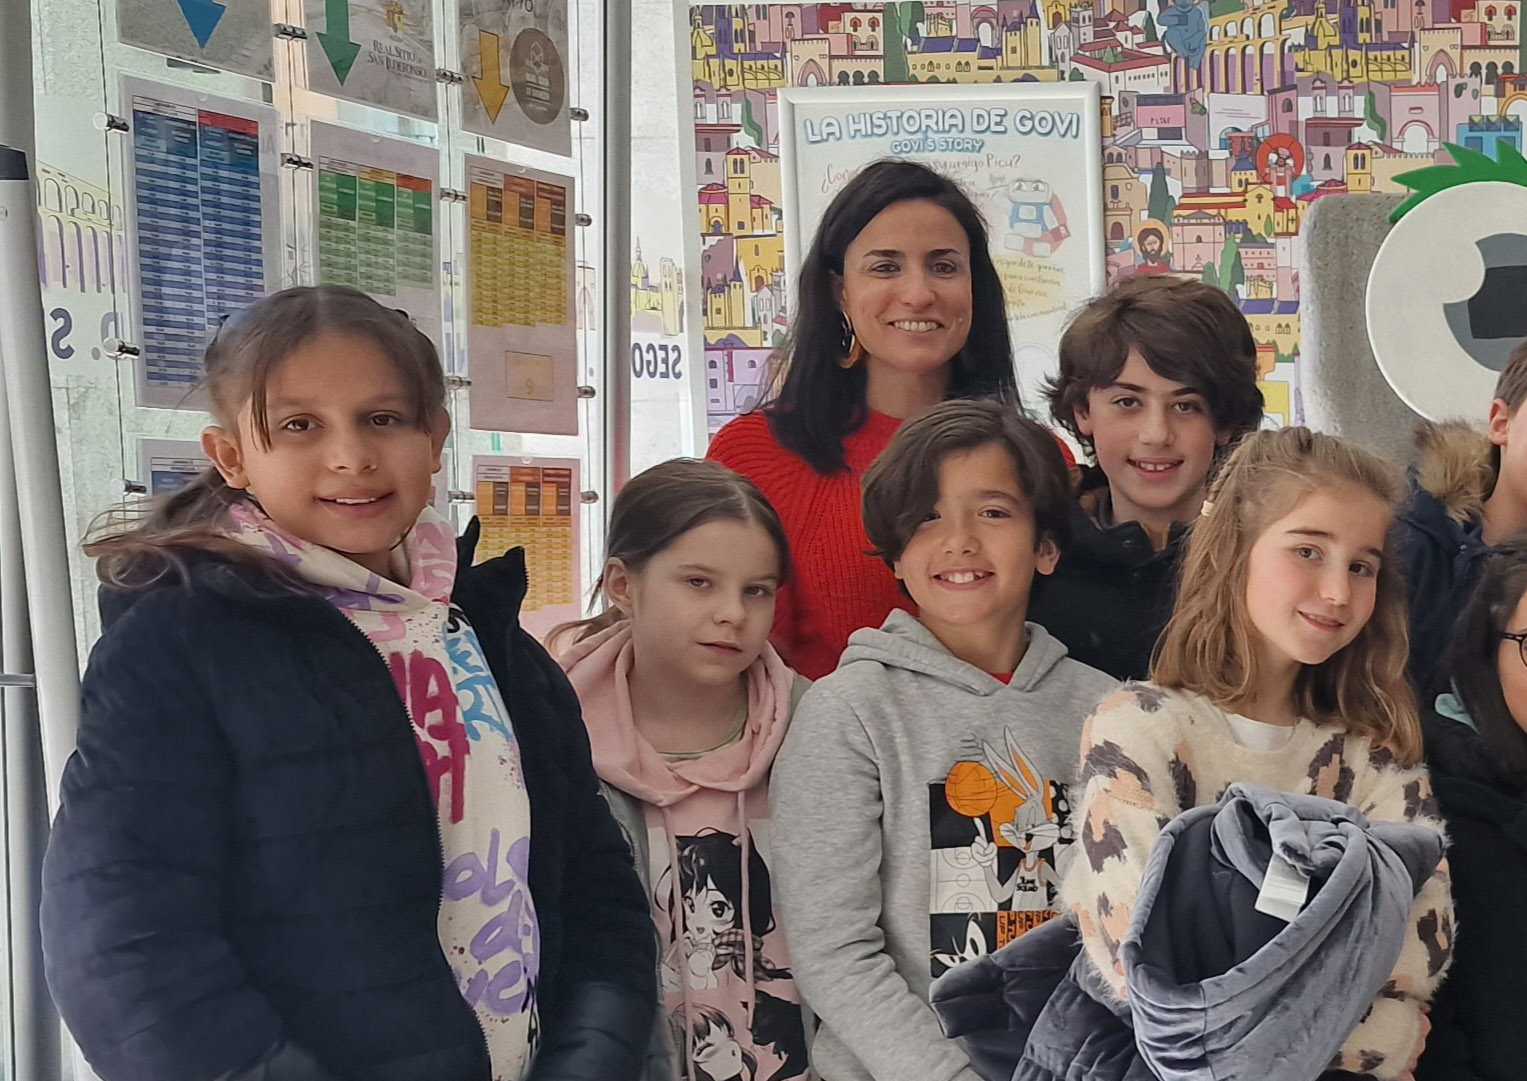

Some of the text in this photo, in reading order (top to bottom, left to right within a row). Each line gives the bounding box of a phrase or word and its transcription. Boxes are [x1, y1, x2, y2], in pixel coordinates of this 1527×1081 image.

[805, 108, 1081, 145] LA HISTORIA DE GOVI
[938, 138, 985, 152] STORY
